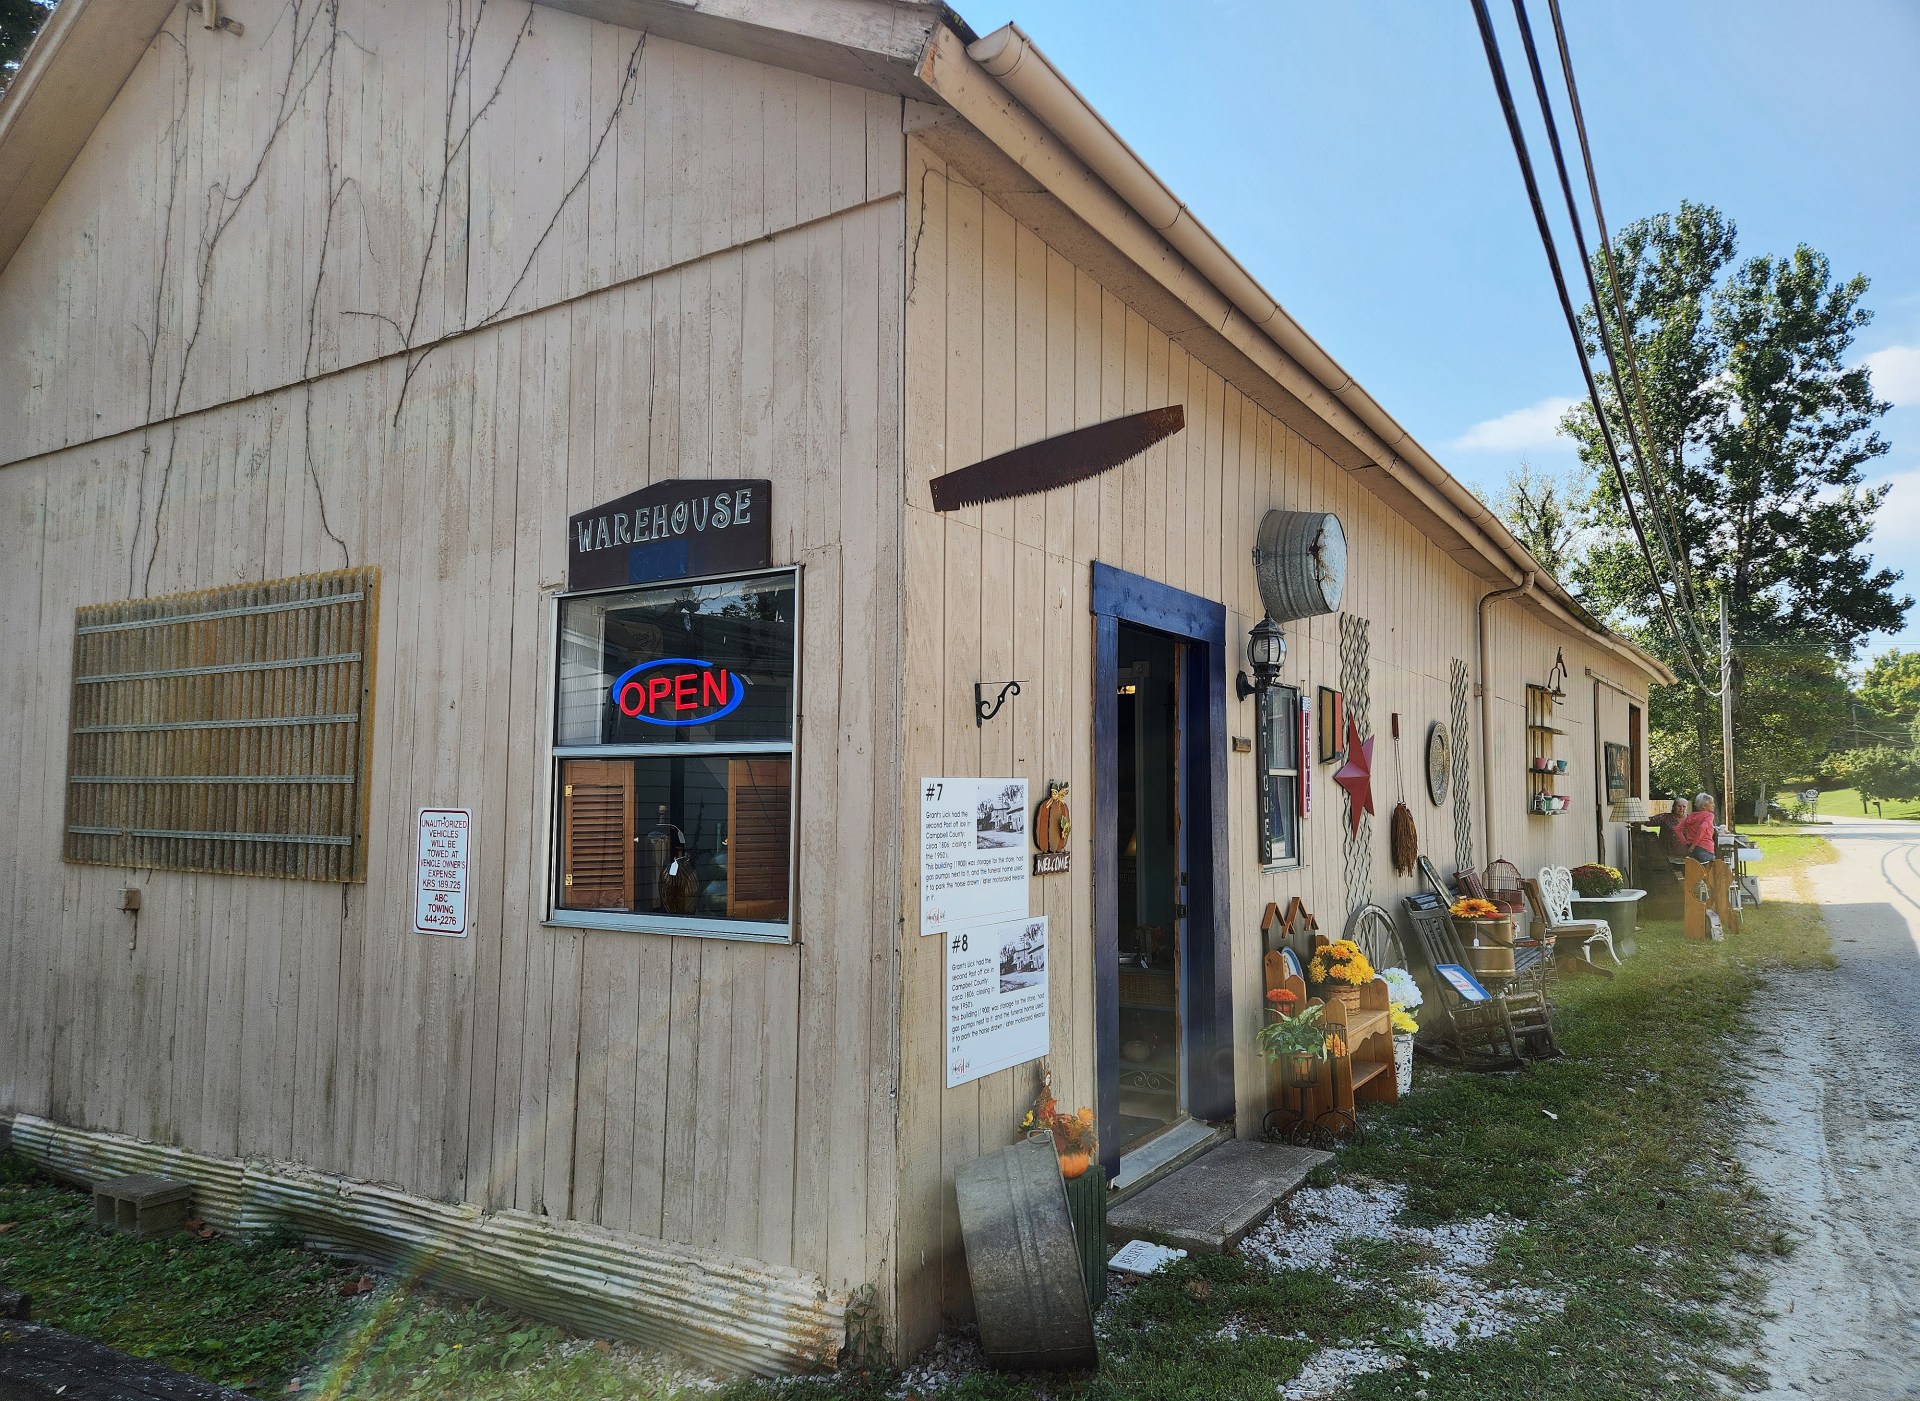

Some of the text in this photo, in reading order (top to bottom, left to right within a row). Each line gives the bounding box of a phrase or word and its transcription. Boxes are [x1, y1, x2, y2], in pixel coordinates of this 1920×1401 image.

[577, 488, 752, 552] WAREHOUSE
[619, 669, 727, 716] OPEN
[1262, 692, 1271, 857] ANTIQUES
[926, 783, 943, 801] #7
[422, 820, 467, 828] UNAUTHORIZED
[429, 830, 458, 838] VEHICLES
[421, 859, 465, 869] VEHICLE OWNER'S
[1037, 855, 1069, 872] WELCOME
[428, 870, 456, 878] EXPENSE
[423, 879, 435, 887] KRS
[434, 894, 448, 902] ABC
[428, 904, 453, 914] TOWING
[424, 915, 456, 925] 444-2276
[952, 934, 968, 954] #8
